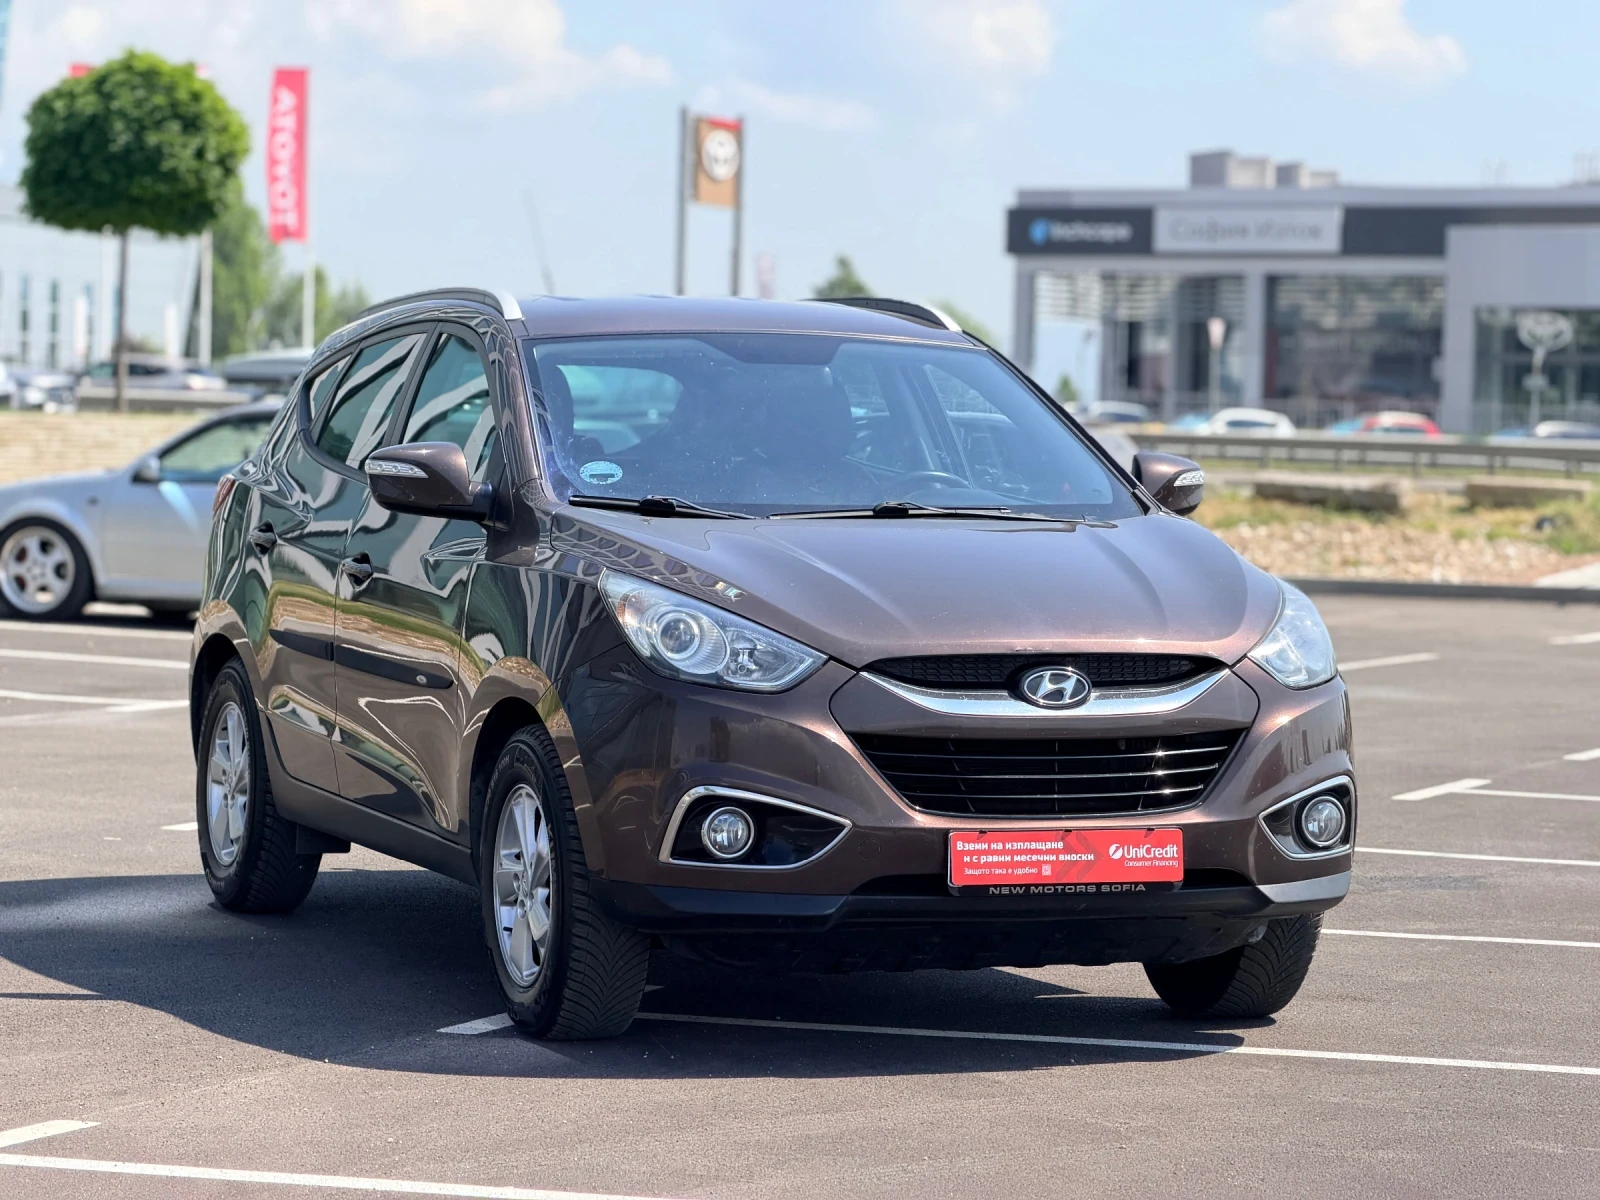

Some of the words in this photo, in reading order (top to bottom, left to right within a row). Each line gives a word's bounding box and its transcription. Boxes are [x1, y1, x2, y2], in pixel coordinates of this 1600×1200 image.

[957, 841, 988, 851] Вземи
[991, 842, 1003, 850] на
[1005, 841, 1064, 851] изплащане
[1124, 844, 1178, 859] UniCredit
[980, 855, 1011, 864] равни
[1014, 854, 1056, 862] месечни
[1152, 860, 1178, 868] Financing
[964, 867, 989, 875] Защото
[1014, 867, 1038, 875] удобно
[989, 886, 1025, 895] NEW
[1030, 885, 1096, 894] MOTORS
[1101, 884, 1146, 892] SOFIA
